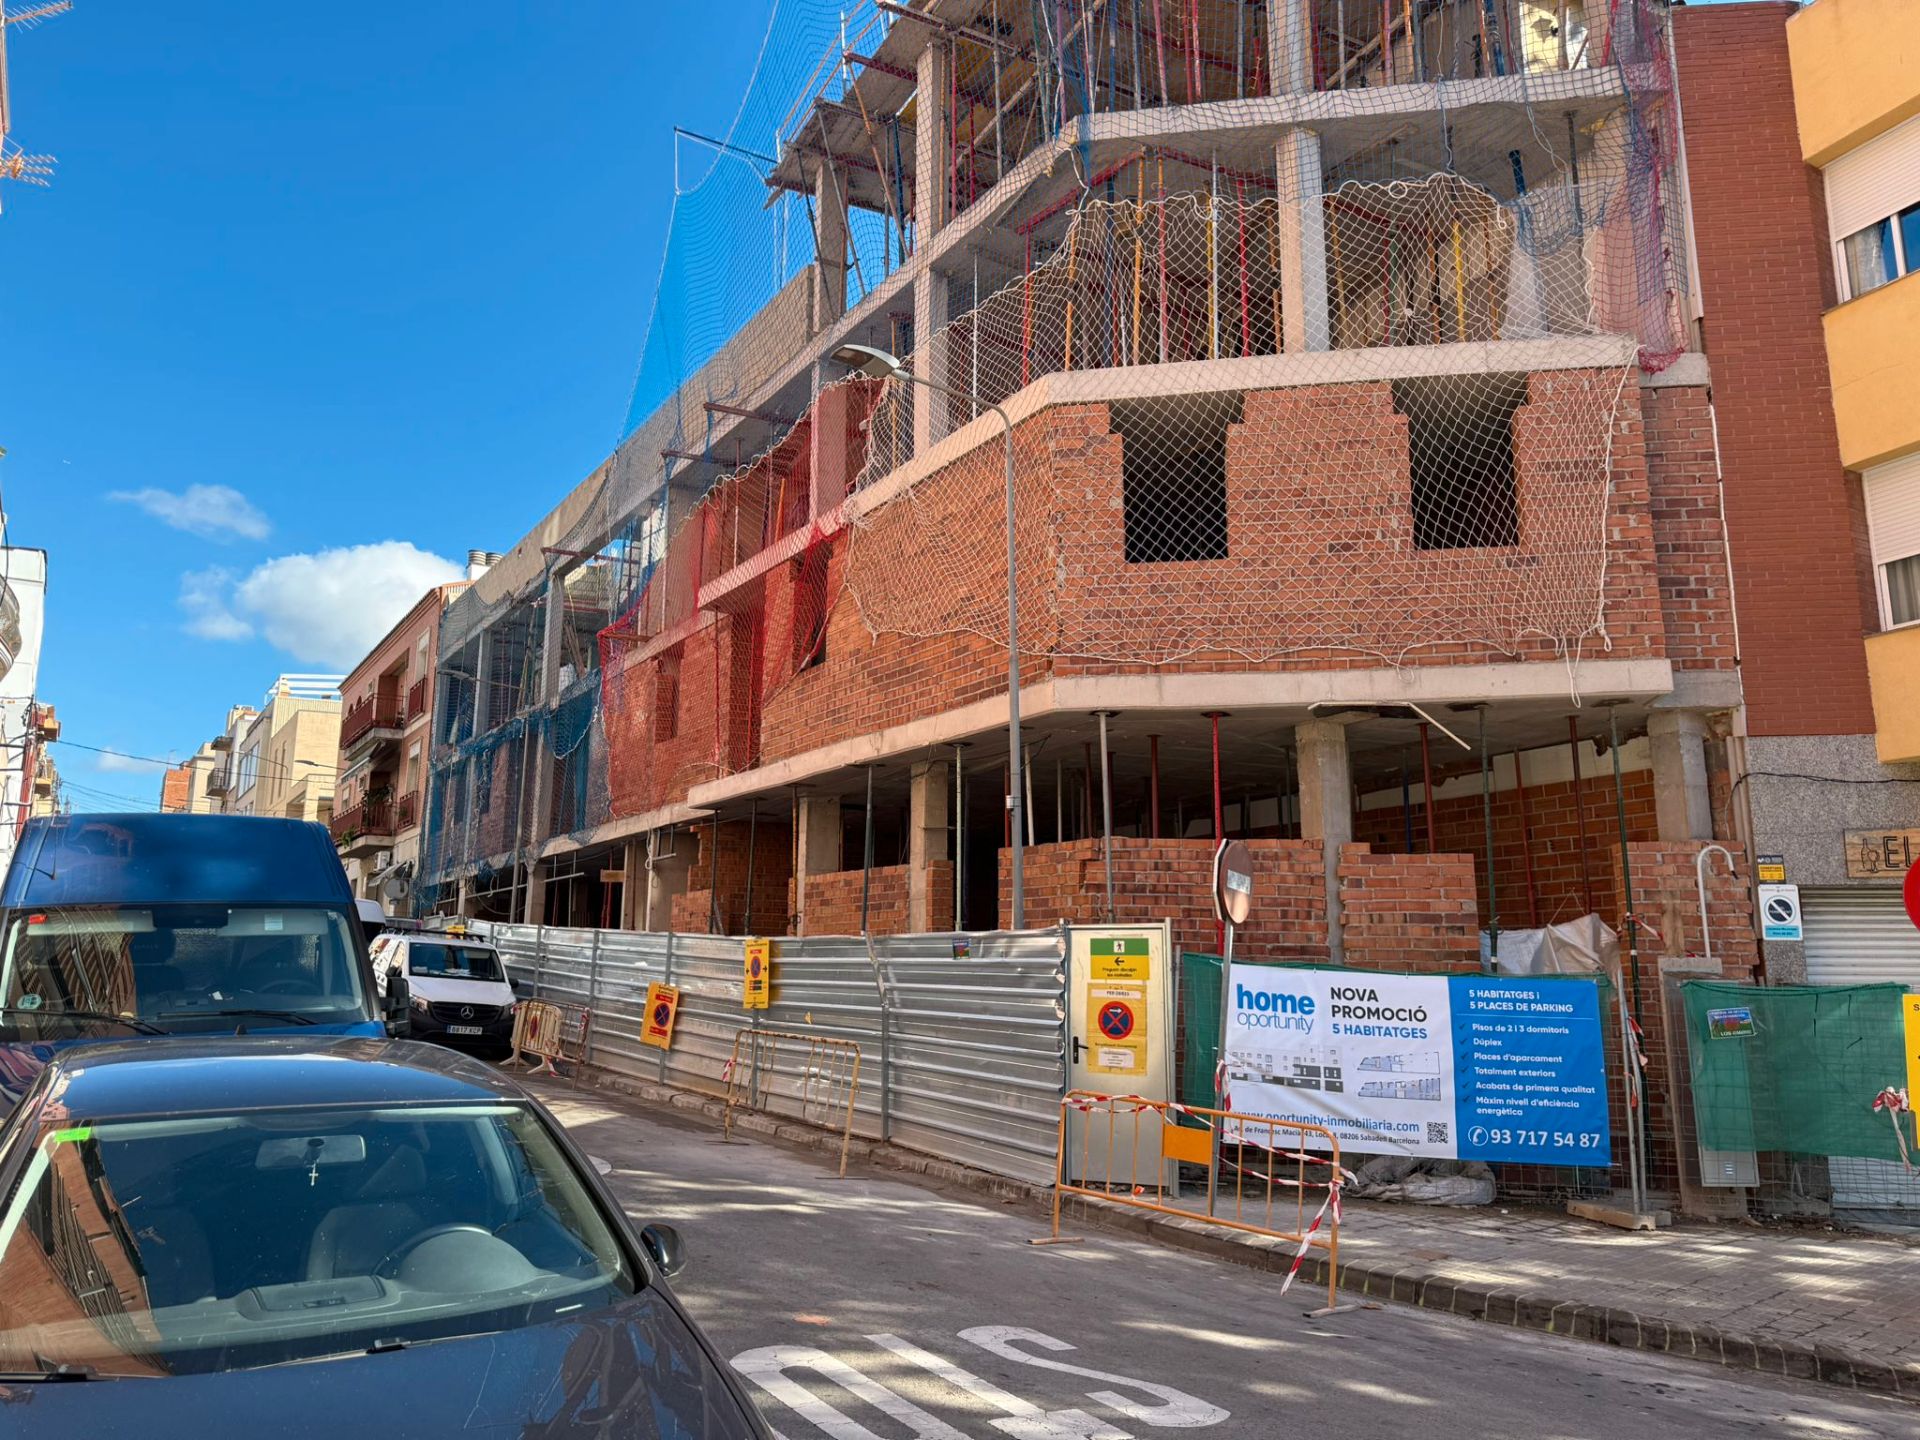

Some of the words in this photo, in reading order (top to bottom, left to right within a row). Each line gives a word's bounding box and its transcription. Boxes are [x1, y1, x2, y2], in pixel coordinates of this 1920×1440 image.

[1237, 983, 1315, 1015] home
[1330, 987, 1379, 1002] NOVA
[1477, 990, 1534, 999] HABITATGES
[1478, 1002, 1513, 1011] PLACES
[1516, 1003, 1529, 1011] DE
[1531, 1004, 1574, 1013] PARKING
[1332, 1005, 1427, 1023] PROMOCIÓ
[1237, 1012, 1314, 1035] oportunity
[1472, 1023, 1493, 1032] Pisos
[1495, 1024, 1506, 1032] de
[1518, 1025, 1525, 1033] 3
[1526, 1025, 1569, 1034] dormitoris
[1332, 1024, 1340, 1034] 5
[1344, 1024, 1427, 1039] HABITATGES
[1473, 1038, 1502, 1047] Dúplex
[1474, 1052, 1501, 1061] Places
[1503, 1053, 1563, 1063] d'aparcament
[1474, 1067, 1517, 1076] Totalment
[1519, 1069, 1556, 1077] exteriors
[1476, 1082, 1510, 1090] Acabats
[1512, 1083, 1523, 1091] de
[1525, 1084, 1559, 1093] primera
[1561, 1085, 1595, 1094] qualitat
[1476, 1096, 1504, 1105] Màxim
[1506, 1097, 1529, 1106] nivell
[1476, 1107, 1523, 1116] energètica
[1234, 1111, 1420, 1132] woortunity-inmobiliaria.com
[1254, 1127, 1280, 1135] Franesc
[1315, 1131, 1330, 1139] Loca
[1490, 1129, 1512, 1144] 93
[1517, 1130, 1548, 1145] 717
[1553, 1132, 1575, 1147] 54
[1580, 1133, 1600, 1148] 87
